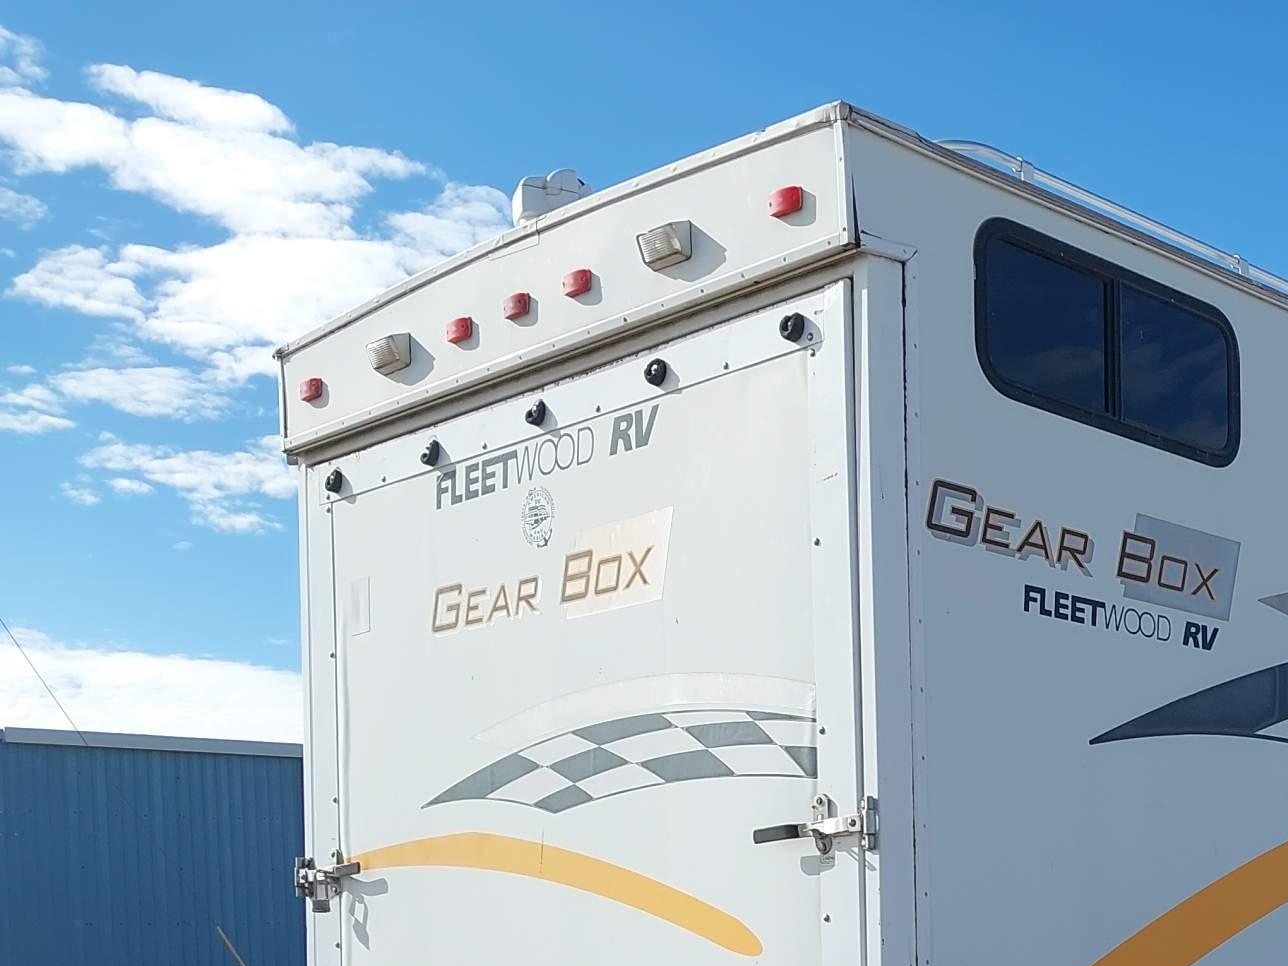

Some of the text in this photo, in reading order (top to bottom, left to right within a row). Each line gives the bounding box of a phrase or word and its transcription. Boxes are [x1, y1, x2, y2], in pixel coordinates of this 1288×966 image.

[435, 404, 660, 510] FLEETWOOD RV
[926, 479, 1091, 572] GEAR
[431, 576, 542, 633] GEAR
[1023, 584, 1219, 651] FLEETWOOD RV
